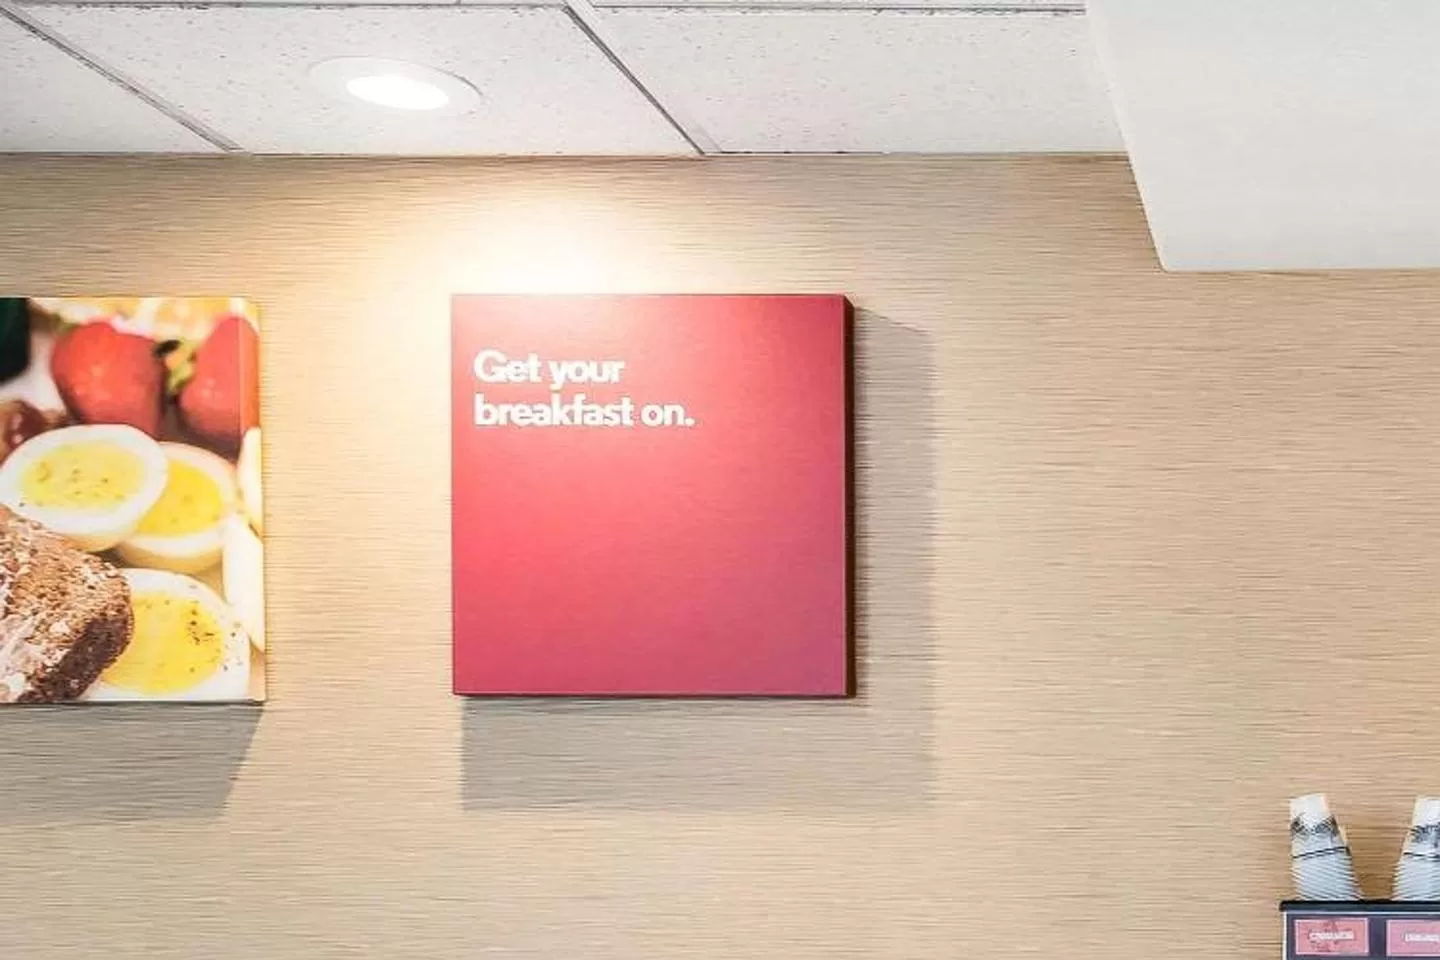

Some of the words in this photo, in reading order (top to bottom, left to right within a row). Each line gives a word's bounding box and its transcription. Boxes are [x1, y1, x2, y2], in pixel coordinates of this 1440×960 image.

[474, 349, 541, 384] Get
[549, 360, 626, 391] your
[474, 394, 633, 427] breakfast
[641, 404, 696, 427] on.
